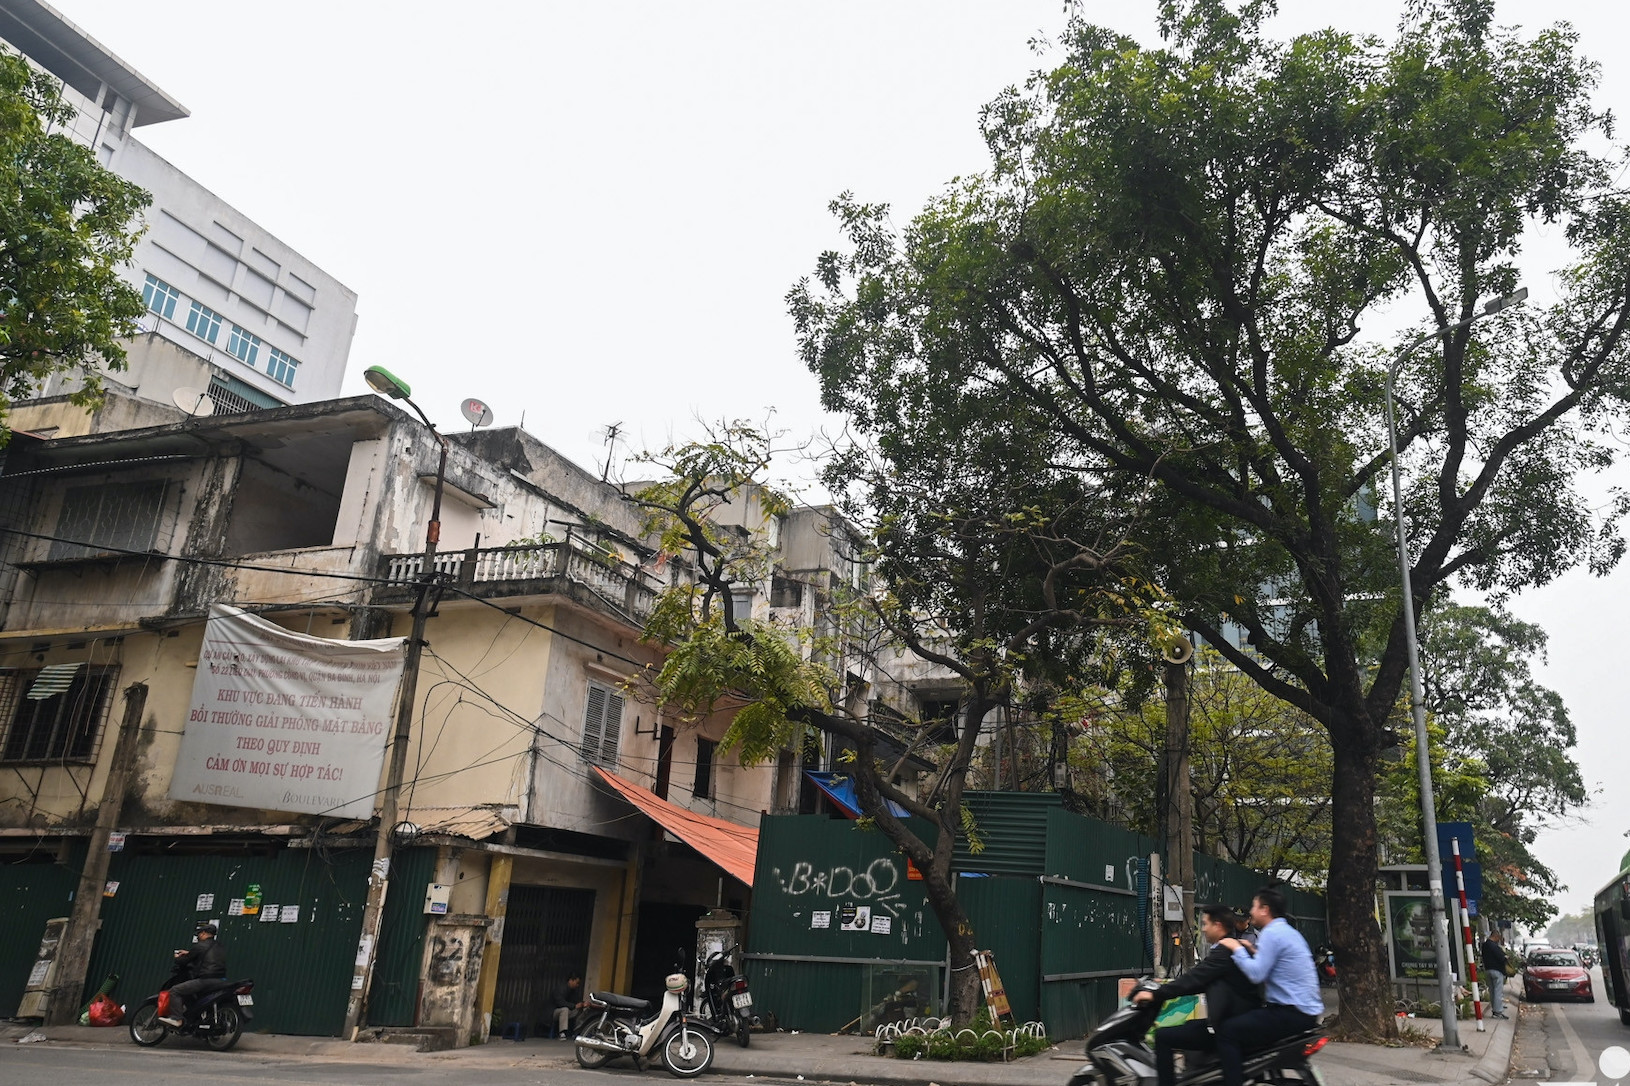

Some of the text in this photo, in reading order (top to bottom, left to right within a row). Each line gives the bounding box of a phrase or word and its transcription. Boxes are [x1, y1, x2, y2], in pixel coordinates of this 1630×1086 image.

[217, 689, 363, 710] KHU VỰC ĐANG TIẾN HÀNH
[190, 703, 383, 736] BỒI THƯỜNG GIẢI PHÓNG MẶT BẰNG
[236, 736, 321, 757] THEO QUY ĐỊNH
[206, 753, 343, 781] CẢM ƠN MỌI SỰ HỢP TÁC!
[282, 790, 345, 808] BOULEVARD
